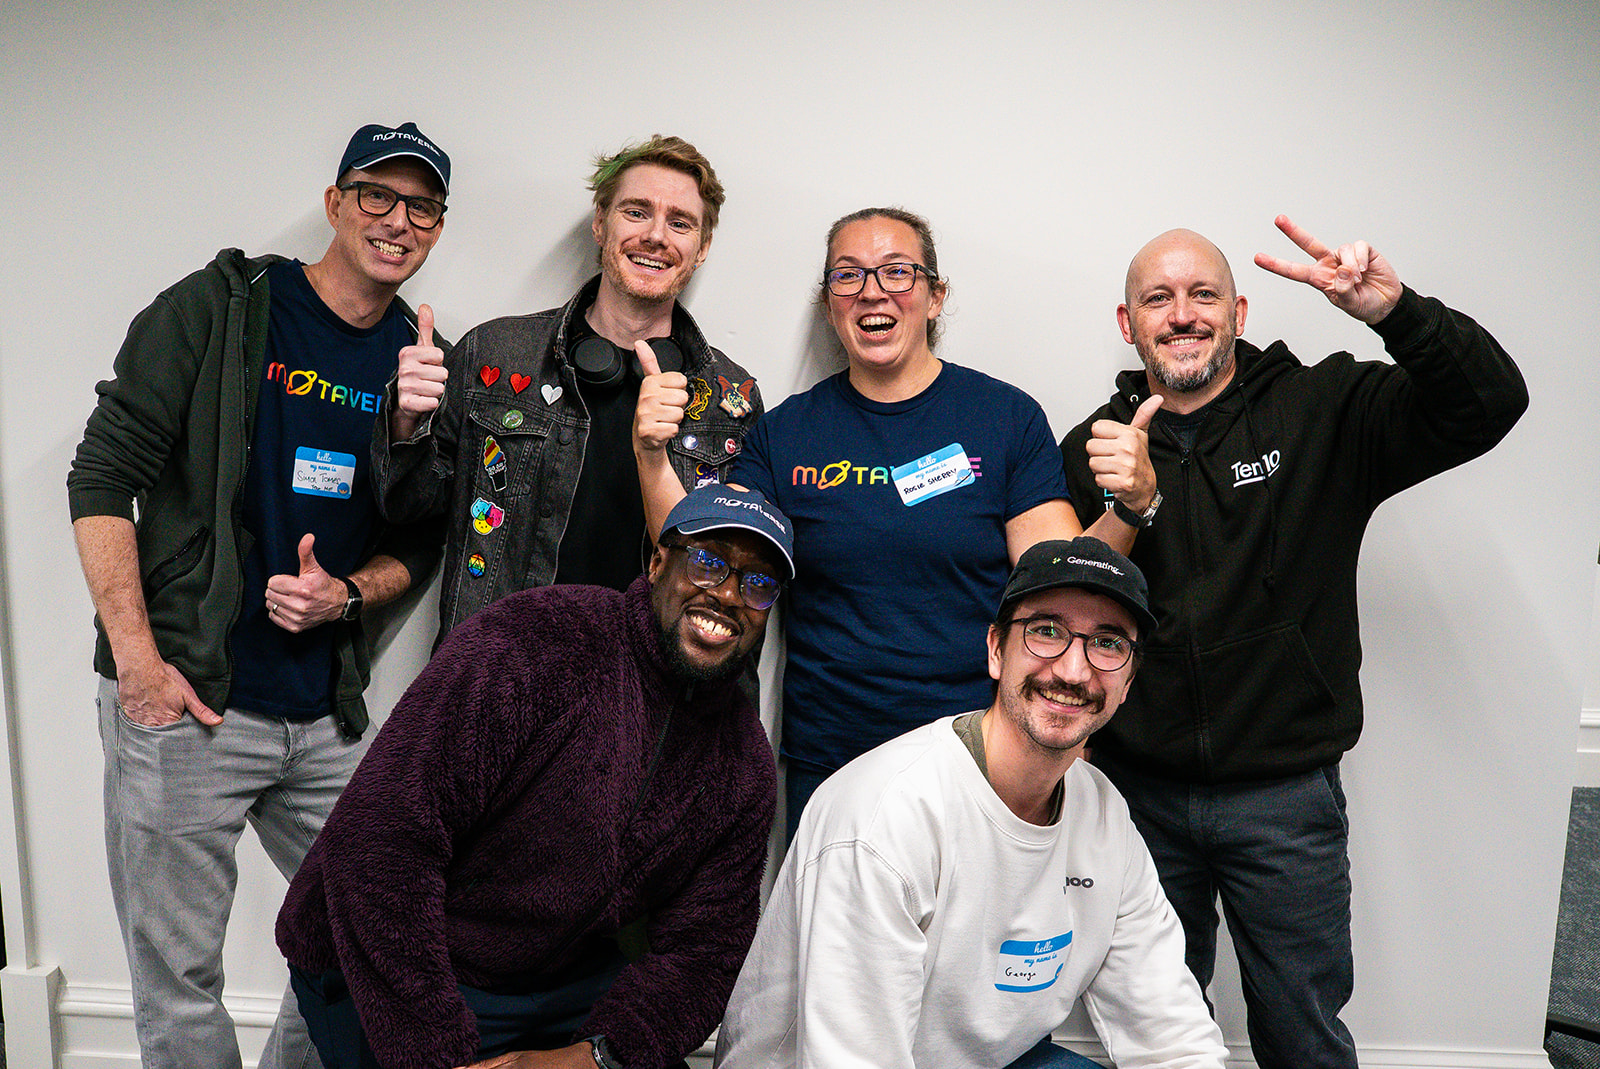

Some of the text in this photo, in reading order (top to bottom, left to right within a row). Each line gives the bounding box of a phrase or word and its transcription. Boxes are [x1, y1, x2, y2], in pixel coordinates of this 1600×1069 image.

[316, 451, 332, 462] hello
[917, 455, 937, 469] hello
[1231, 450, 1280, 481] Ten10
[1034, 940, 1053, 954] hello
[1024, 959, 1035, 967] my
